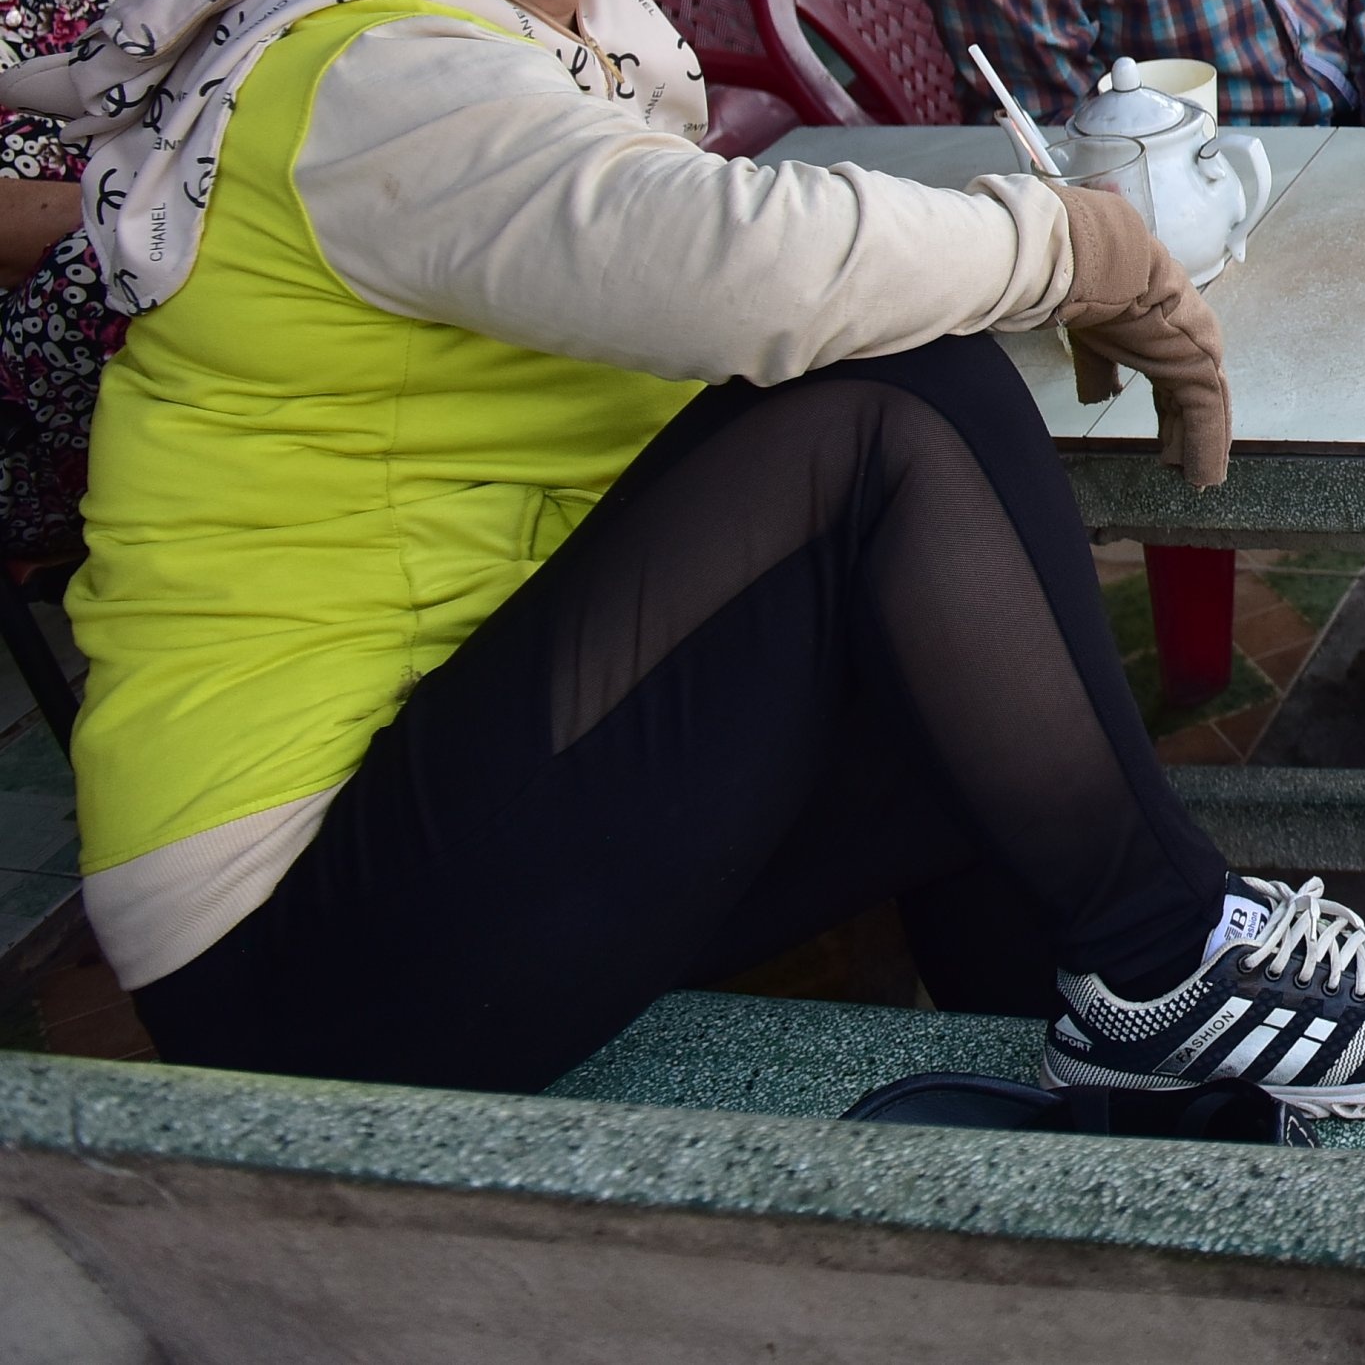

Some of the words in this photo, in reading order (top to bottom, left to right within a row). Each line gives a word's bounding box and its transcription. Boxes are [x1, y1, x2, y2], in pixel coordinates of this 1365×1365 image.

[150, 202, 166, 262] CHANEL
[1055, 1031, 1093, 1053] SPORT
[1175, 1010, 1235, 1064] FASHION
